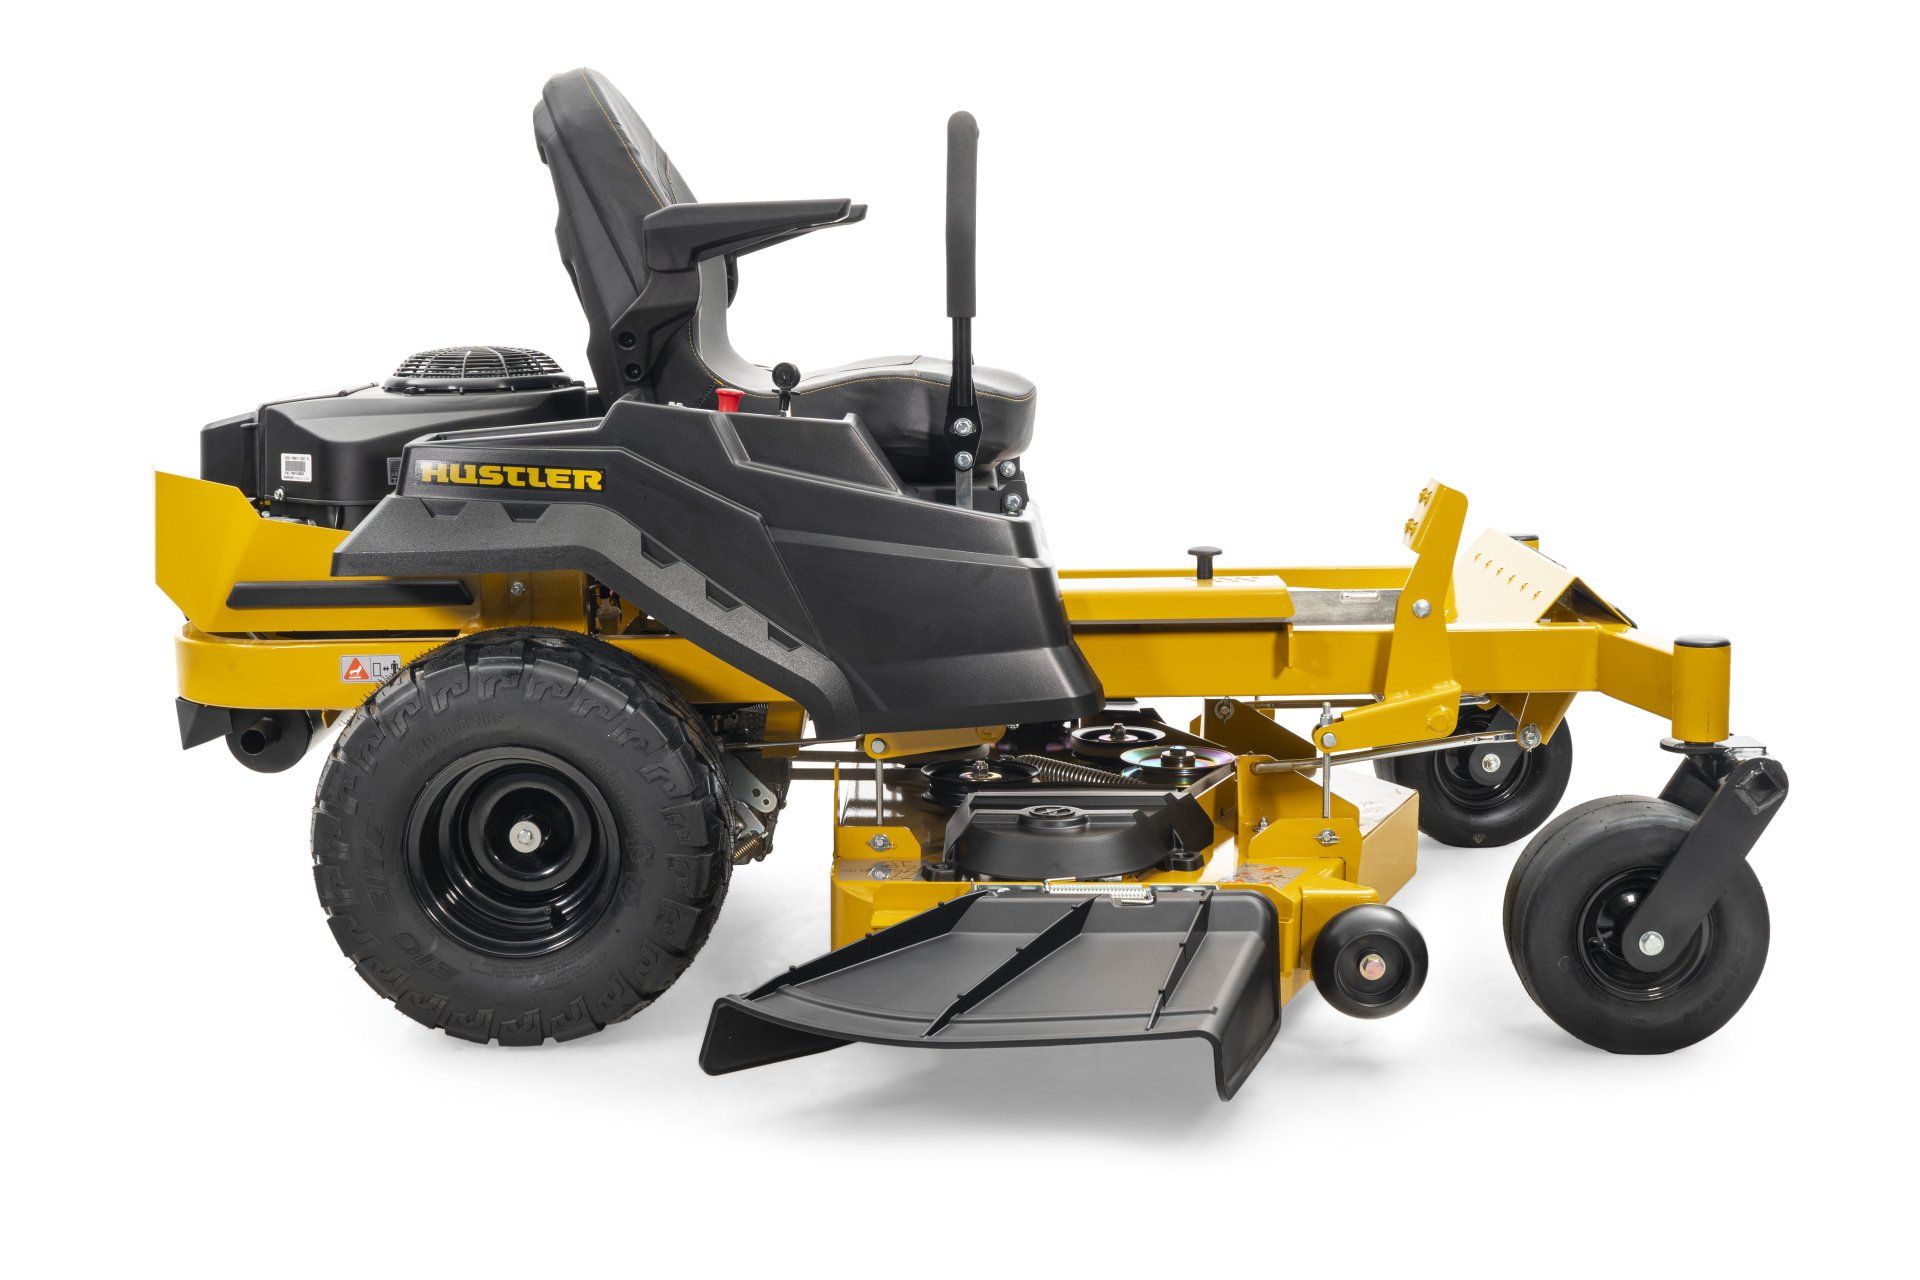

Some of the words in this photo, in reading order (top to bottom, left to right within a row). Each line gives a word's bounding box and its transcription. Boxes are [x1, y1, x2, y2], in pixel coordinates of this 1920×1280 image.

[422, 463, 602, 491] HUSTLER
[361, 814, 396, 916] BITE
[390, 931, 465, 985] BIG
